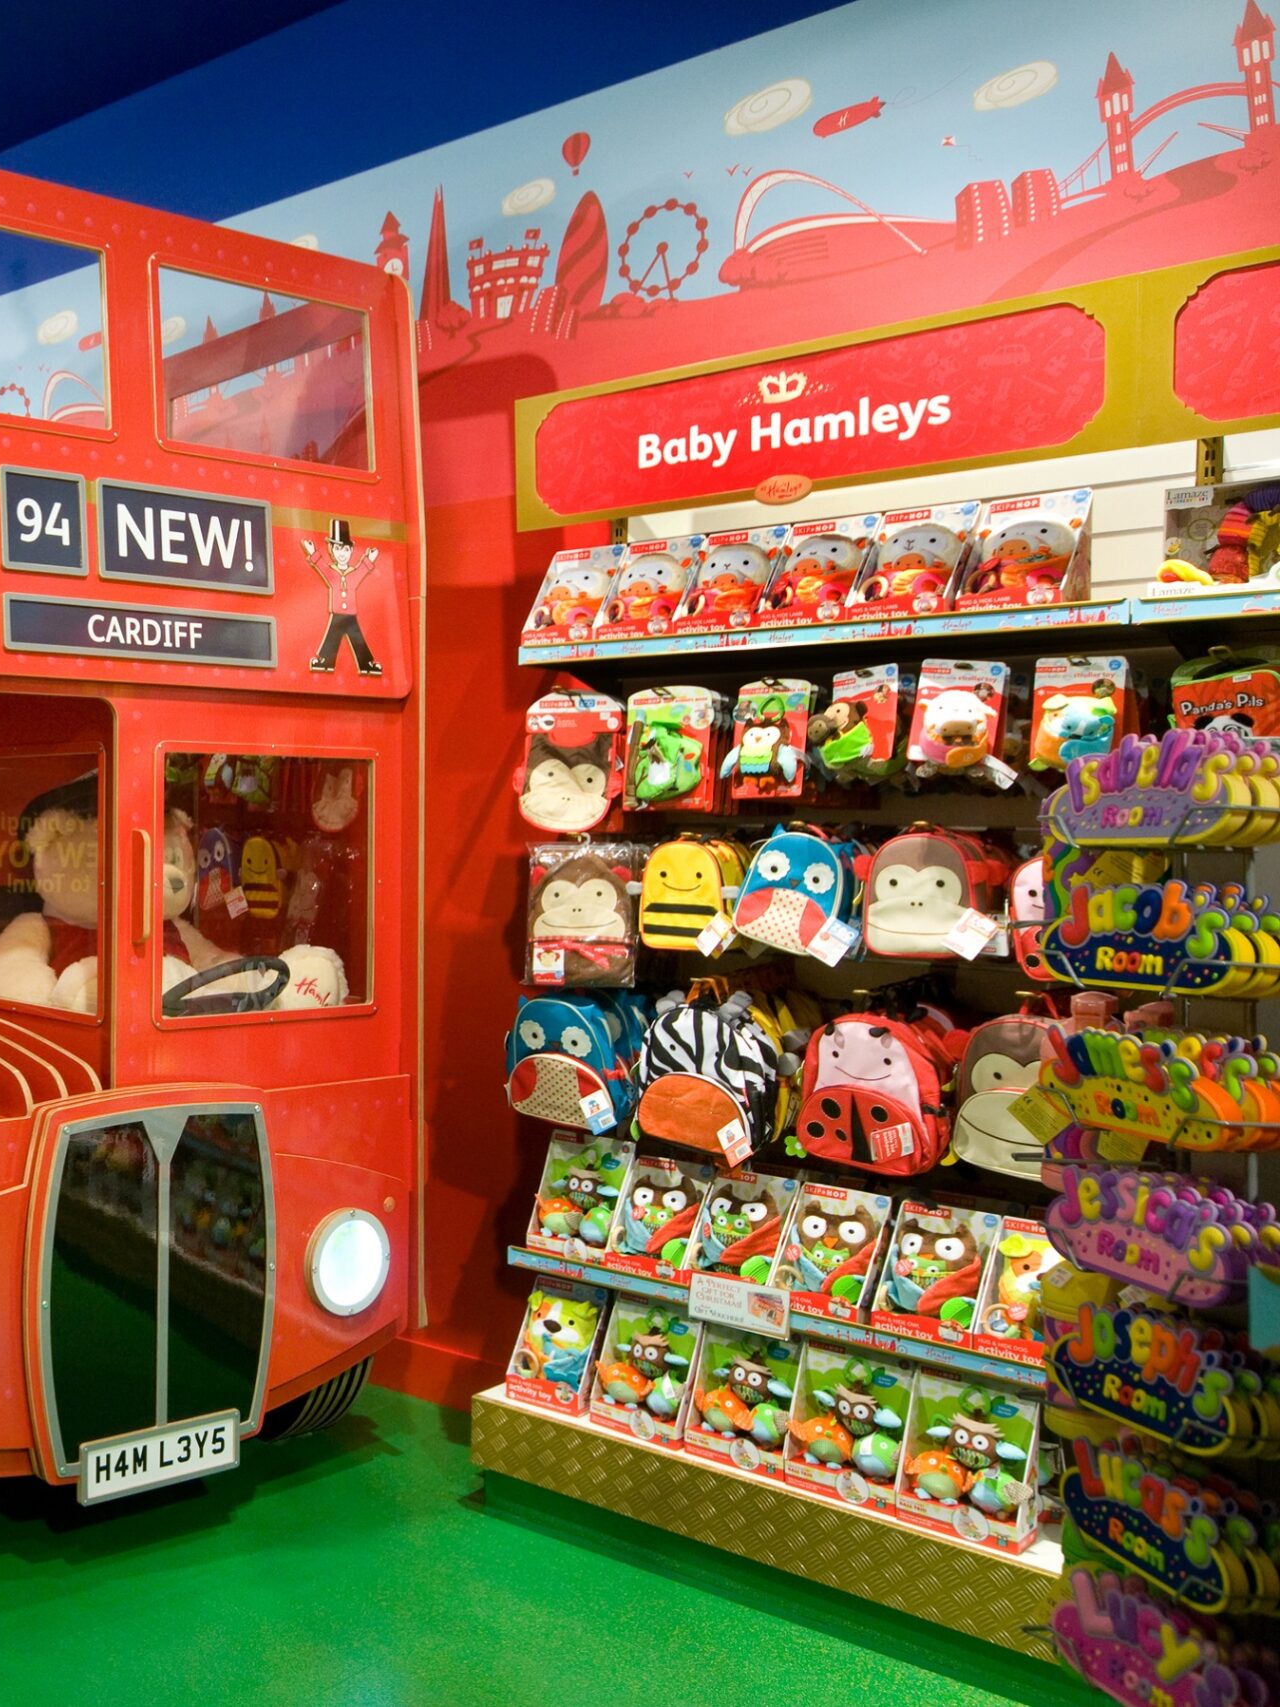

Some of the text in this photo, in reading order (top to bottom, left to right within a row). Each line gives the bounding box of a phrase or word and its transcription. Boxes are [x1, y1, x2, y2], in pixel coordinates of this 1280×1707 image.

[638, 394, 951, 468] Baby Hamleys
[1167, 489, 1209, 500] Lamaze
[991, 499, 1039, 512] SKIP HOP
[16, 497, 70, 546] 94
[909, 511, 930, 520] HOP
[815, 523, 834, 532] HOP
[117, 503, 254, 572] NEW!
[760, 617, 812, 628] activity toy
[852, 609, 908, 621] activity toy
[87, 614, 202, 649] CARDIFF
[677, 624, 725, 634] activity toy
[1181, 699, 1233, 715] Panda's
[1067, 730, 1230, 814] Isabella's
[1059, 881, 1225, 959] Jacob's
[295, 977, 330, 1007] Haml
[805, 1184, 846, 1198] SKIP HOP
[904, 1203, 923, 1212] SKIP
[1005, 1220, 1025, 1231] SKIP
[1059, 1166, 1226, 1272] Jessica's
[808, 1306, 824, 1316] toy
[875, 1322, 933, 1341] activity toy
[978, 1344, 1043, 1366] activity toy
[1069, 1305, 1228, 1418] Joseph's
[95, 1426, 226, 1484] H4M L3Y5
